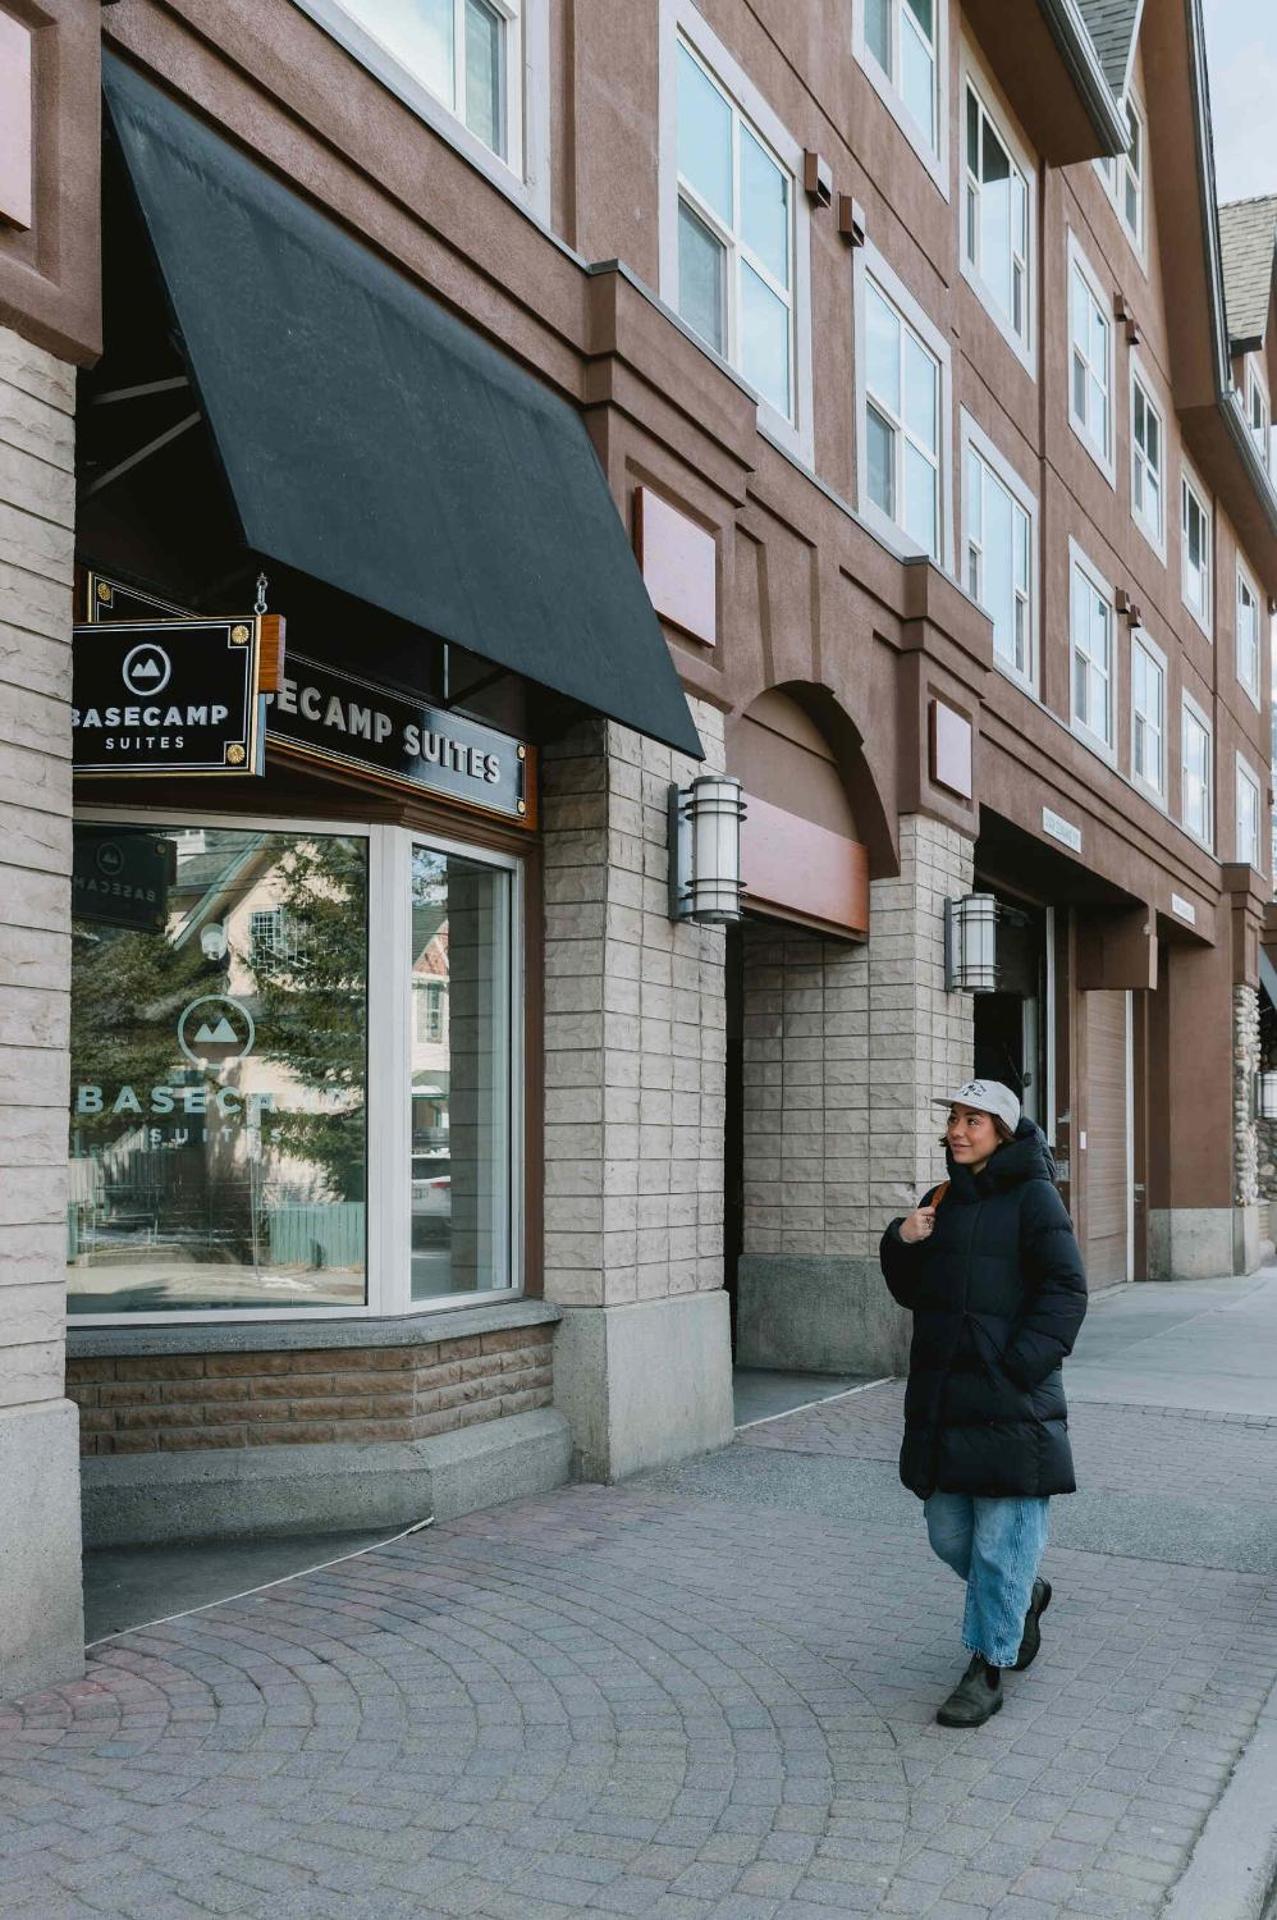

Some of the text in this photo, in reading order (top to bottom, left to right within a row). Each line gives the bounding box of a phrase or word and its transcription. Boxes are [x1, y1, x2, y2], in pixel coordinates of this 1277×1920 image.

[266, 678, 501, 784] ECAMP SUITES
[105, 736, 184, 750] SUITES
[149, 1127, 282, 1144] SUITS
